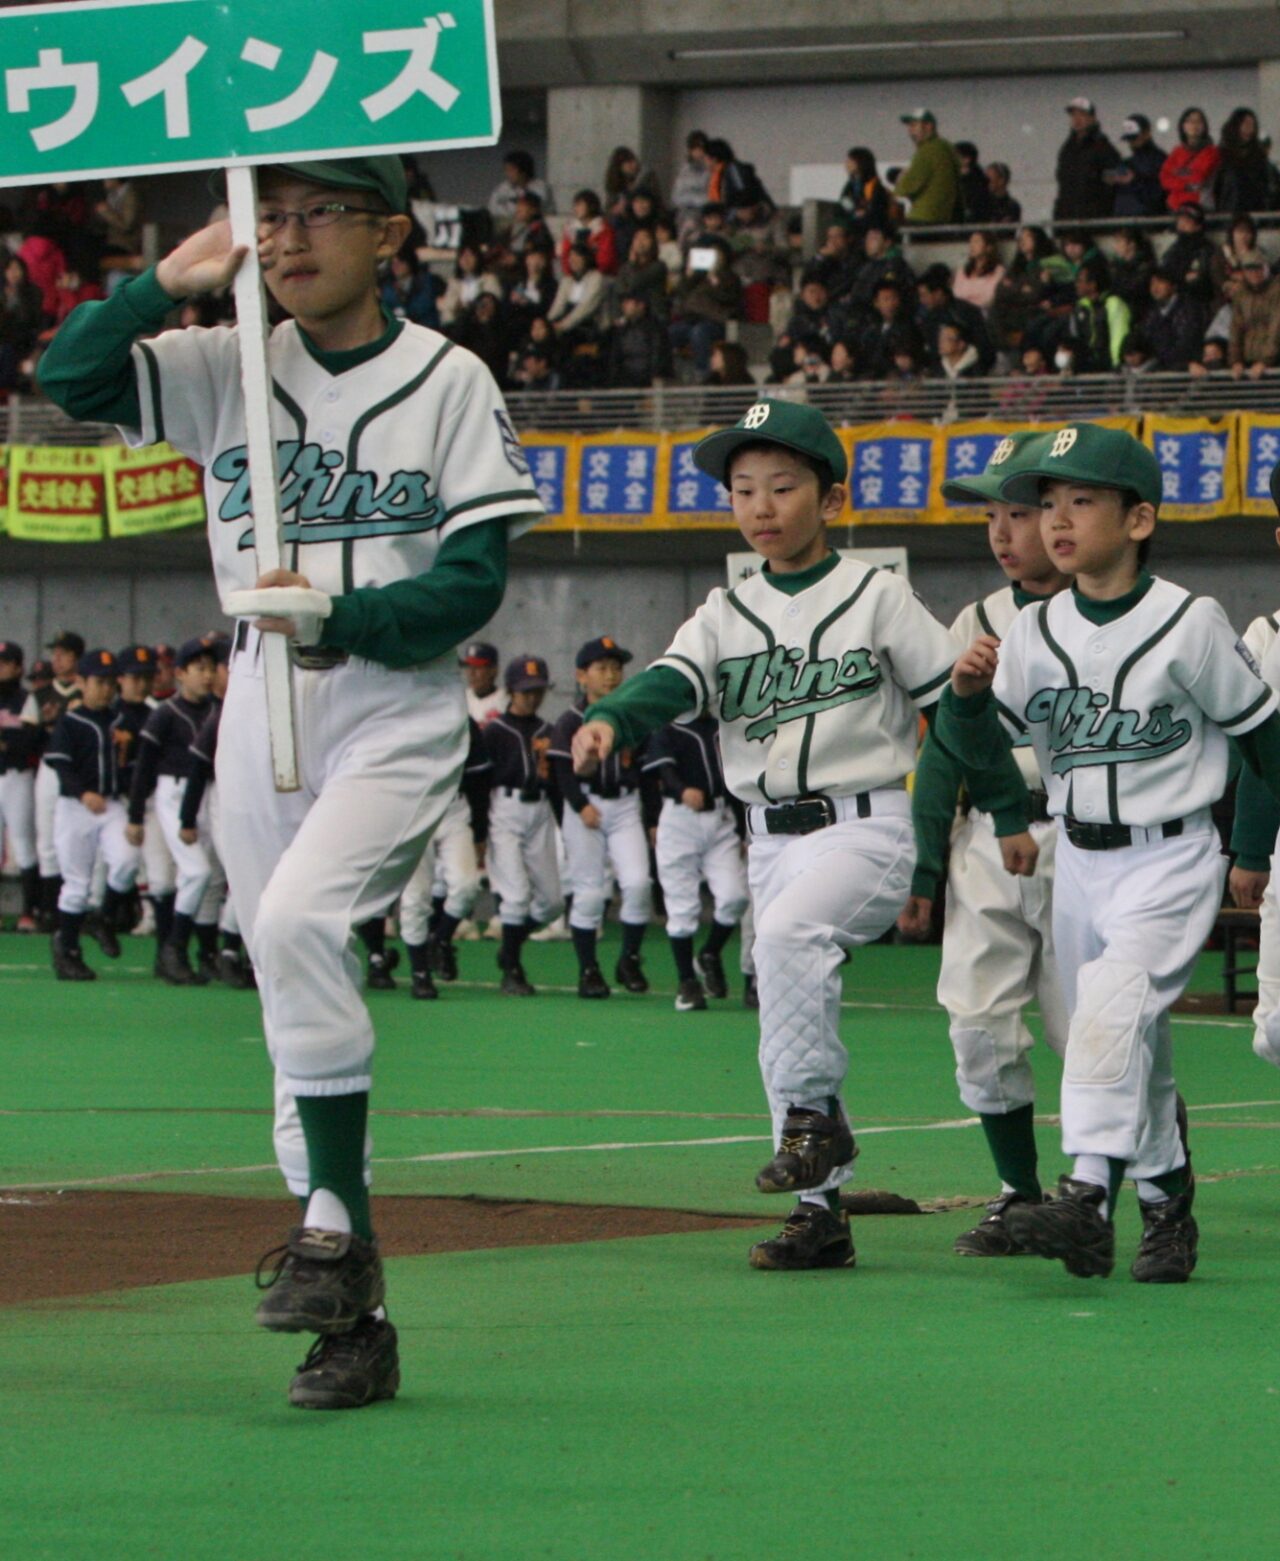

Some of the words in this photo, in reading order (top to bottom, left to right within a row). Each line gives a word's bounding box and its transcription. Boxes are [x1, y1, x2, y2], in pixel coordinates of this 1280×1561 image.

[5, 12, 460, 152] ウインズ
[589, 450, 646, 478] 交通
[860, 443, 922, 472] 交通
[1159, 437, 1223, 466] 交通
[212, 440, 445, 521] Wins
[860, 475, 922, 504] 安全
[588, 481, 646, 510] 安全
[717, 645, 881, 722] Wins
[1025, 687, 1192, 753] Wins
